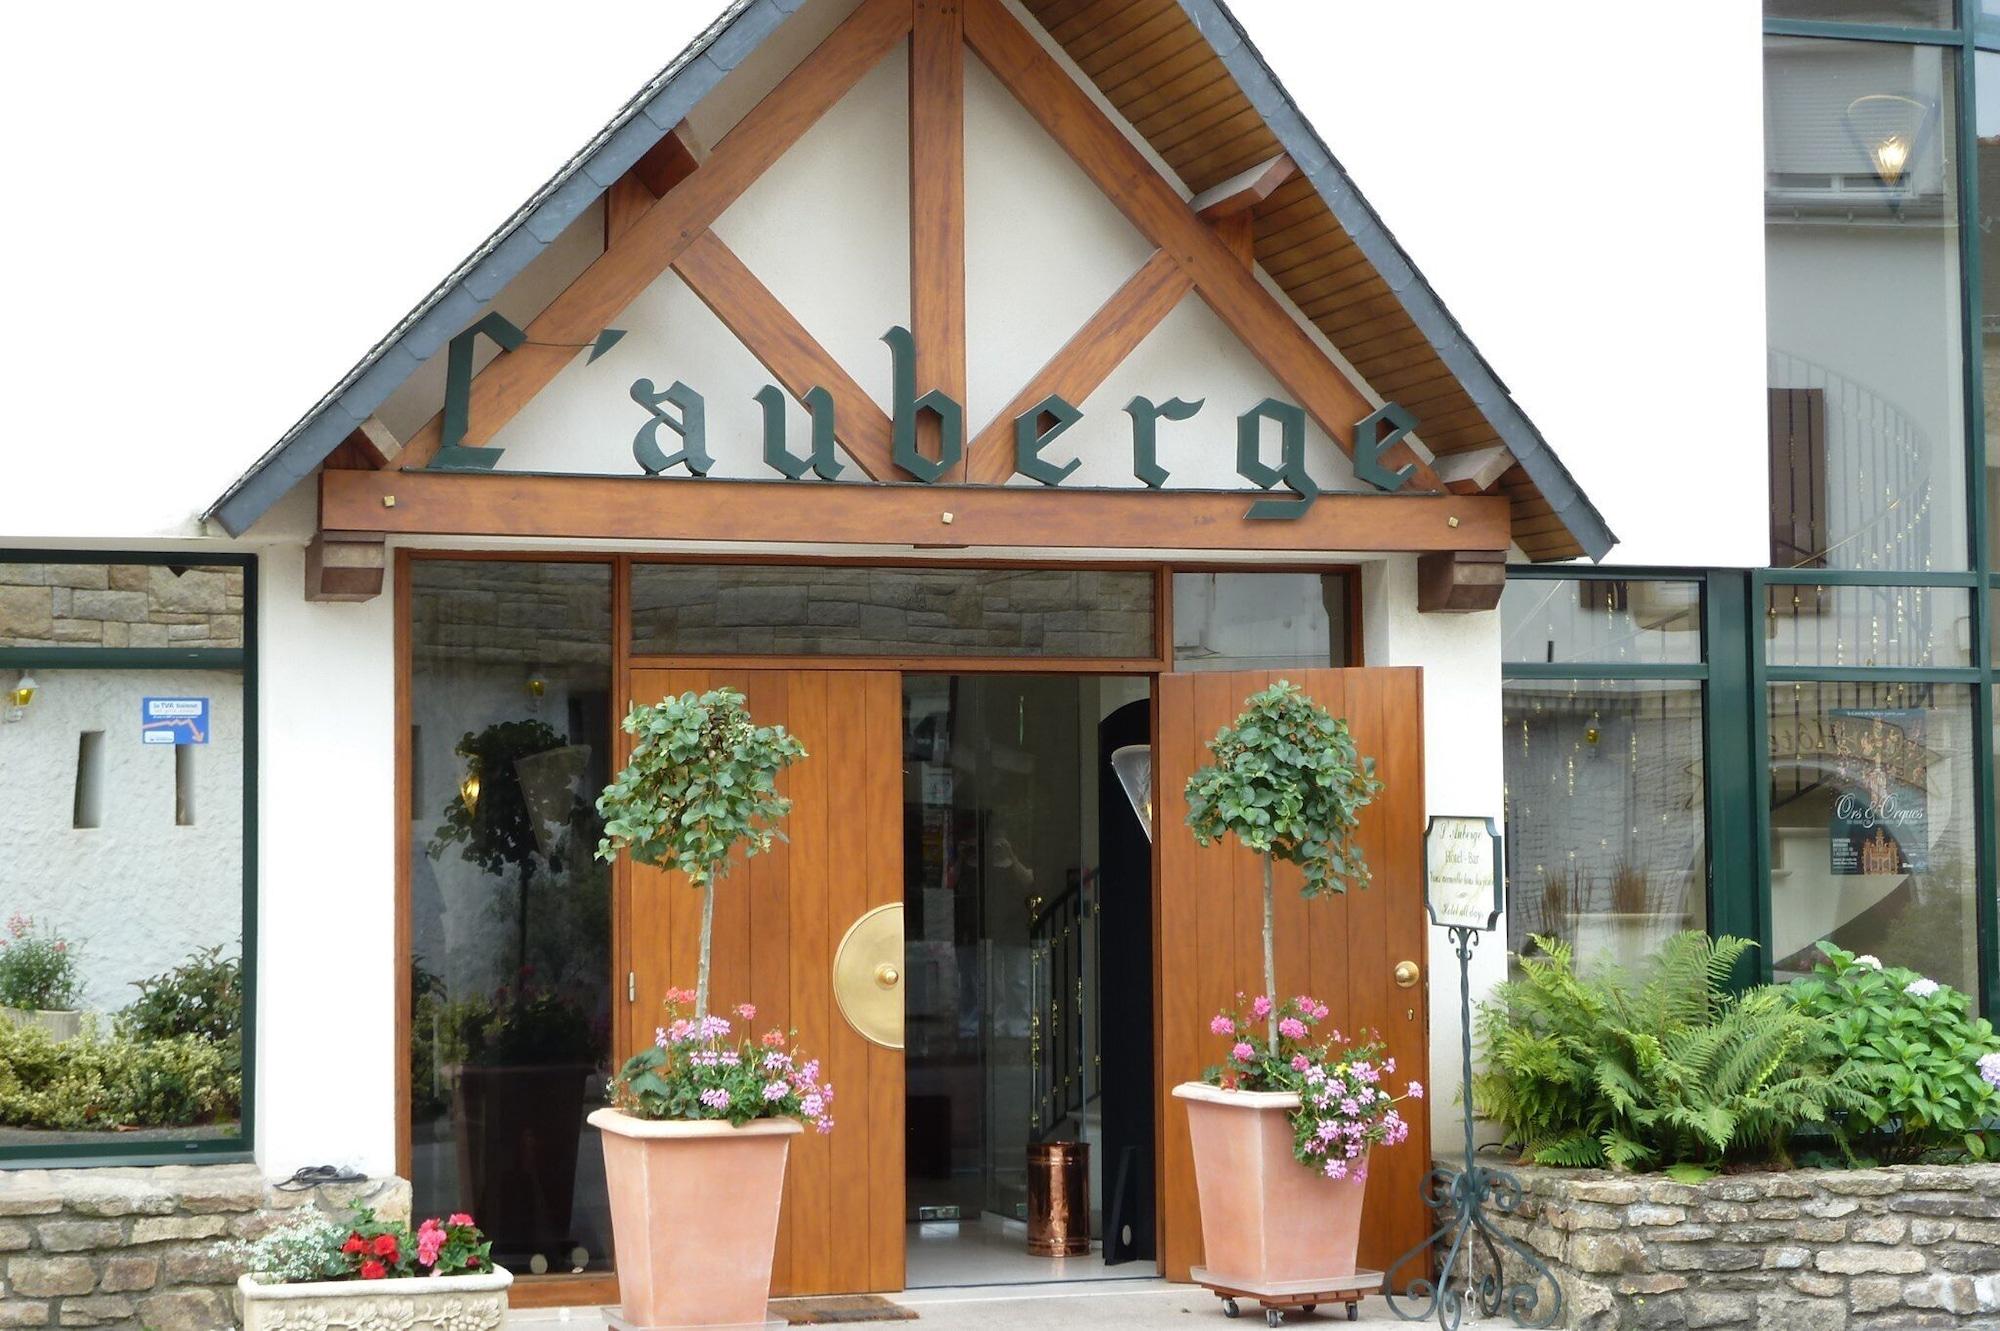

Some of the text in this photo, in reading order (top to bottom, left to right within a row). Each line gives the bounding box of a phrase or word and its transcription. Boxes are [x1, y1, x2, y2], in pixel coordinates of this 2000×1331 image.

[1835, 793, 1924, 829] Ors & Orgues
